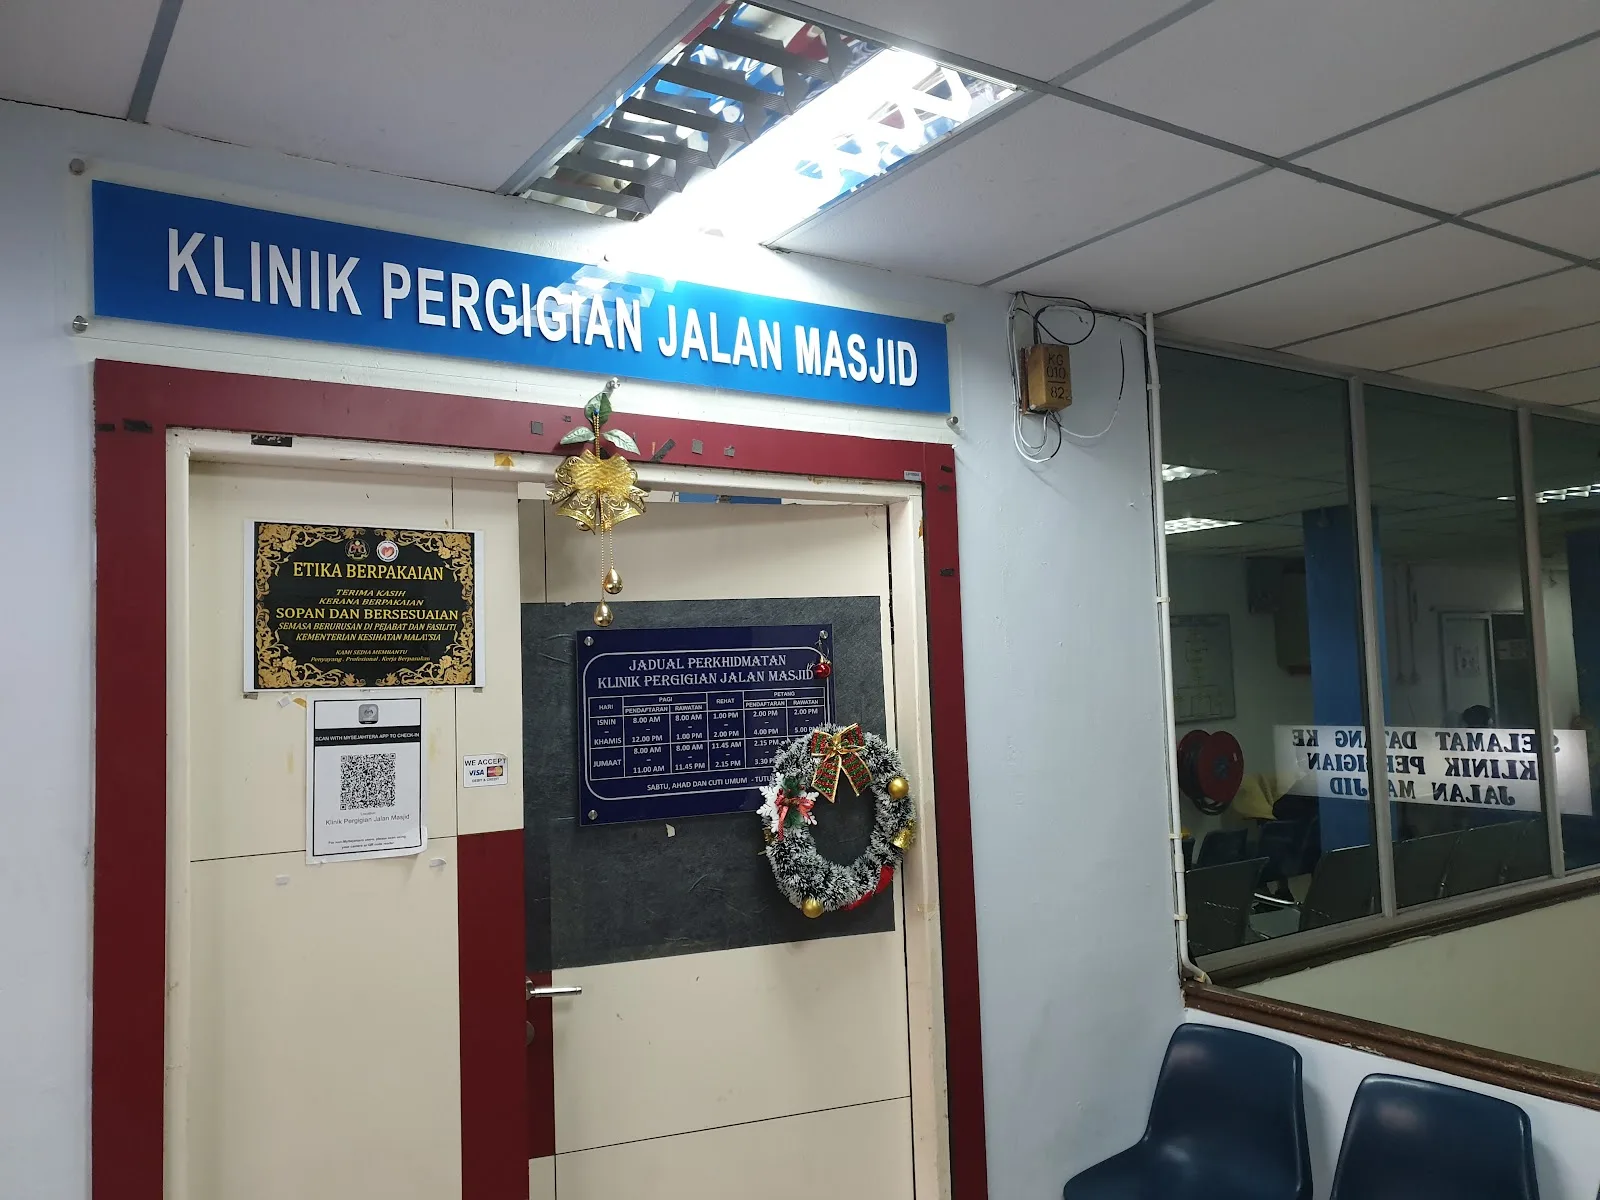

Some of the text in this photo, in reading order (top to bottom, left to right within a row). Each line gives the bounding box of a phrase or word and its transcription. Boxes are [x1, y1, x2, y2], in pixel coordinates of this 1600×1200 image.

[168, 227, 918, 387] KLINIK PERGIGIAN JALAN MASJID
[1048, 353, 1064, 366] KG
[1050, 386, 1065, 399] 82
[293, 562, 443, 580] ETIKA BERPAKAIAN
[336, 589, 374, 597] TERIMA
[276, 607, 458, 620] SOPAN DAN BERSESUAIAN
[278, 622, 457, 632] SEMASA BERURUSAN DI PEJABAT DAN FASILITI
[296, 633, 441, 641] KEMENTERIAN KESIHATAN MALAYSIA
[629, 655, 787, 671] JADUAL PERKHIDMATAN
[597, 669, 814, 689] KLINIK PERGIGIAN JALAN MASJID
[745, 700, 785, 708] PENDAFTARAN
[594, 737, 622, 745] KHAMIS
[711, 742, 730, 750] 11.45
[477, 758, 507, 766] ACCEPT
[593, 759, 622, 768] JUMAAT
[469, 769, 485, 777] VISA
[647, 783, 671, 791] SABTU,
[725, 777, 748, 785] UMUM
[343, 817, 372, 825] Pergigian
